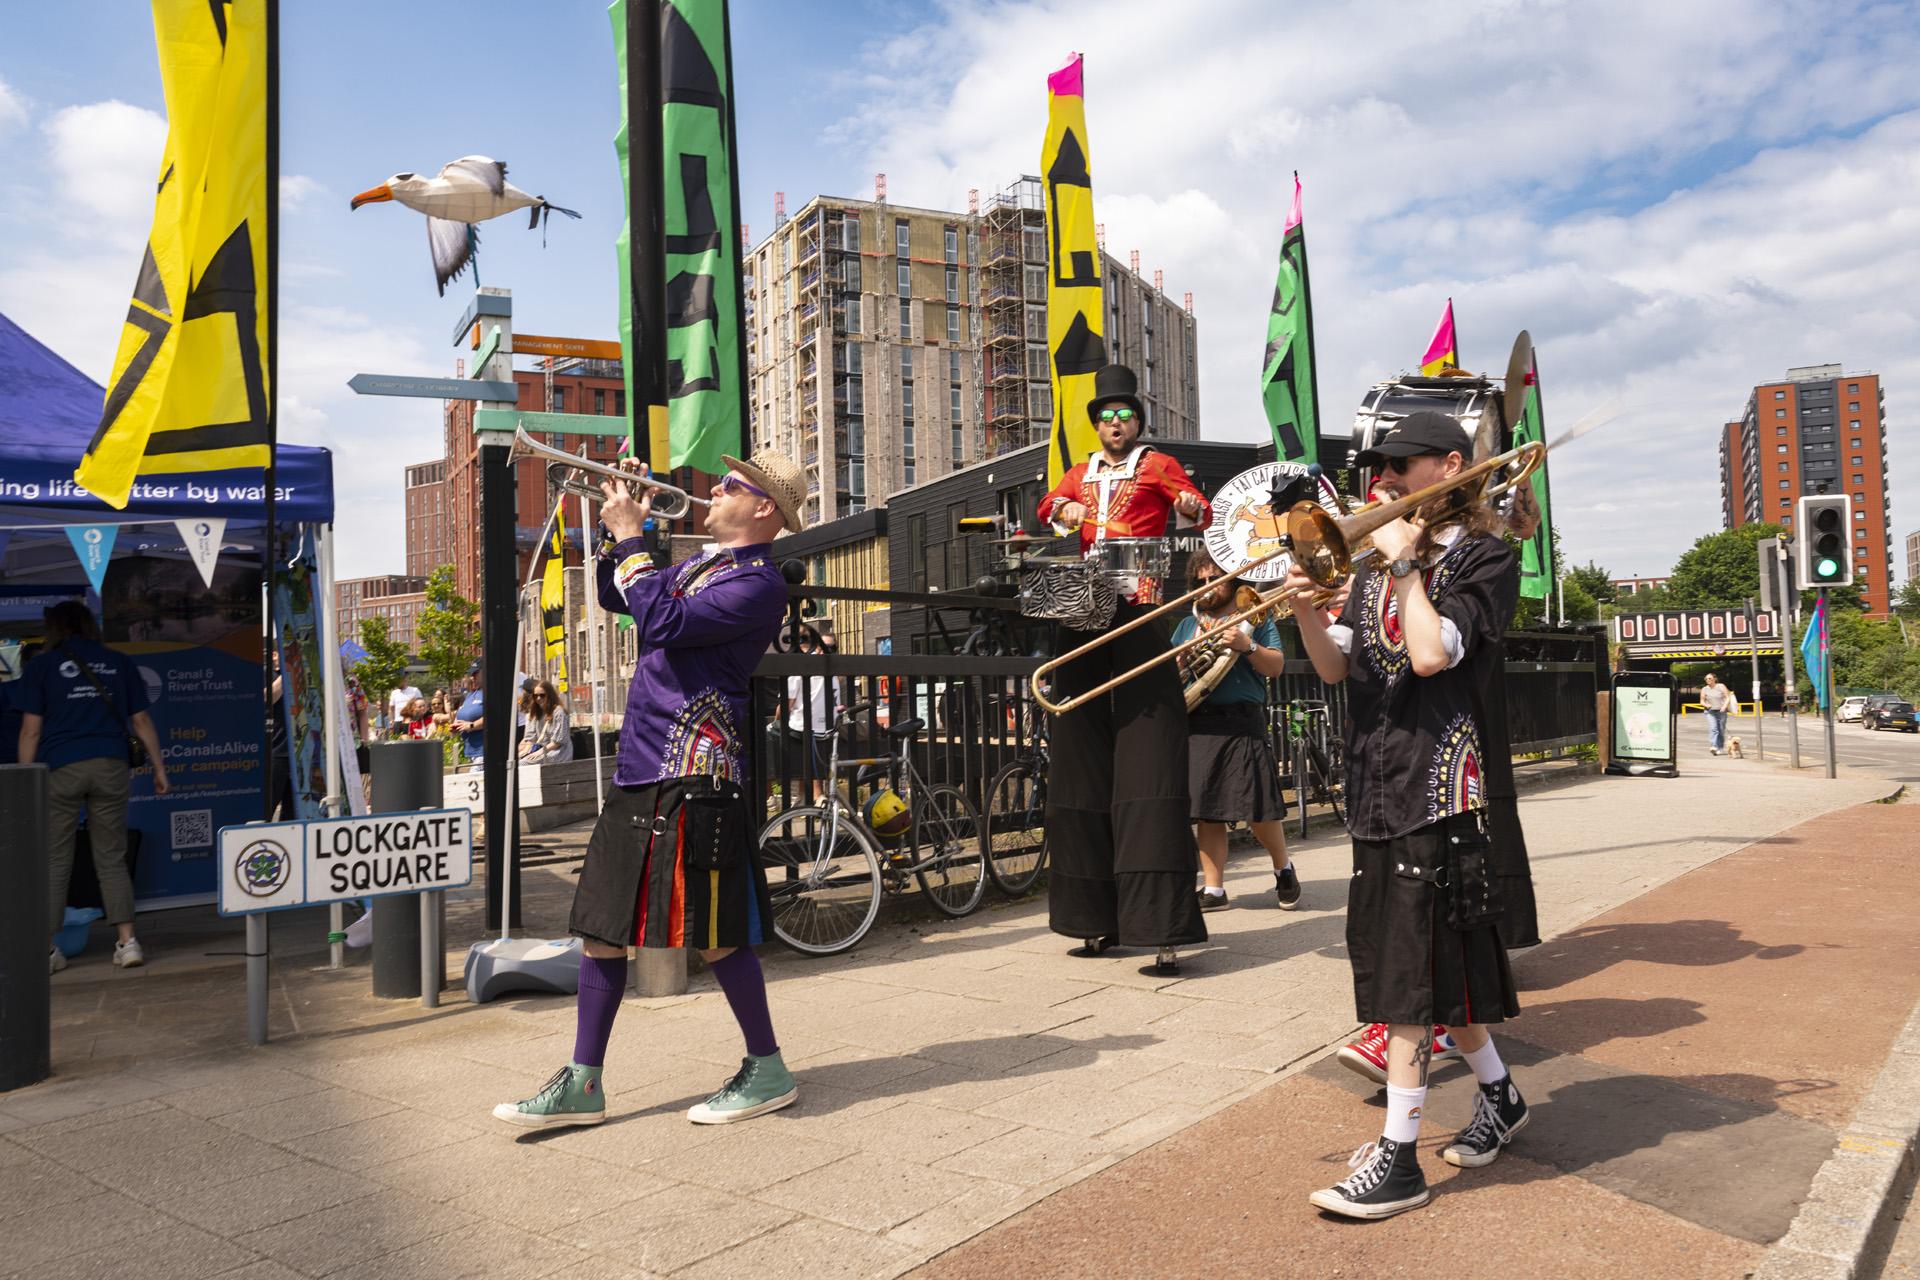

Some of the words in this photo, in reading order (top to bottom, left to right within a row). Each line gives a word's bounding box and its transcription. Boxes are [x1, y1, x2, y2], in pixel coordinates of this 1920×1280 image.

[1231, 479, 1253, 494] FAT
[1253, 466, 1270, 486] CAT
[49, 479, 89, 498] life
[131, 482, 178, 498] tter
[187, 482, 219, 503] by
[1212, 497, 1233, 527] BRASS
[1208, 529, 1228, 545] CAT
[1212, 544, 1235, 562] FAT
[1271, 560, 1288, 577] CAT
[167, 668, 203, 680] Canal
[205, 668, 215, 679] &
[167, 680, 200, 692] River
[200, 679, 234, 690] Trust
[169, 727, 207, 741] Help
[160, 741, 260, 759] pCanalsAlive
[191, 758, 260, 772] campaign
[467, 780, 480, 802] 3
[315, 817, 463, 859] LOCKGATE
[330, 852, 450, 893] SQUARE
